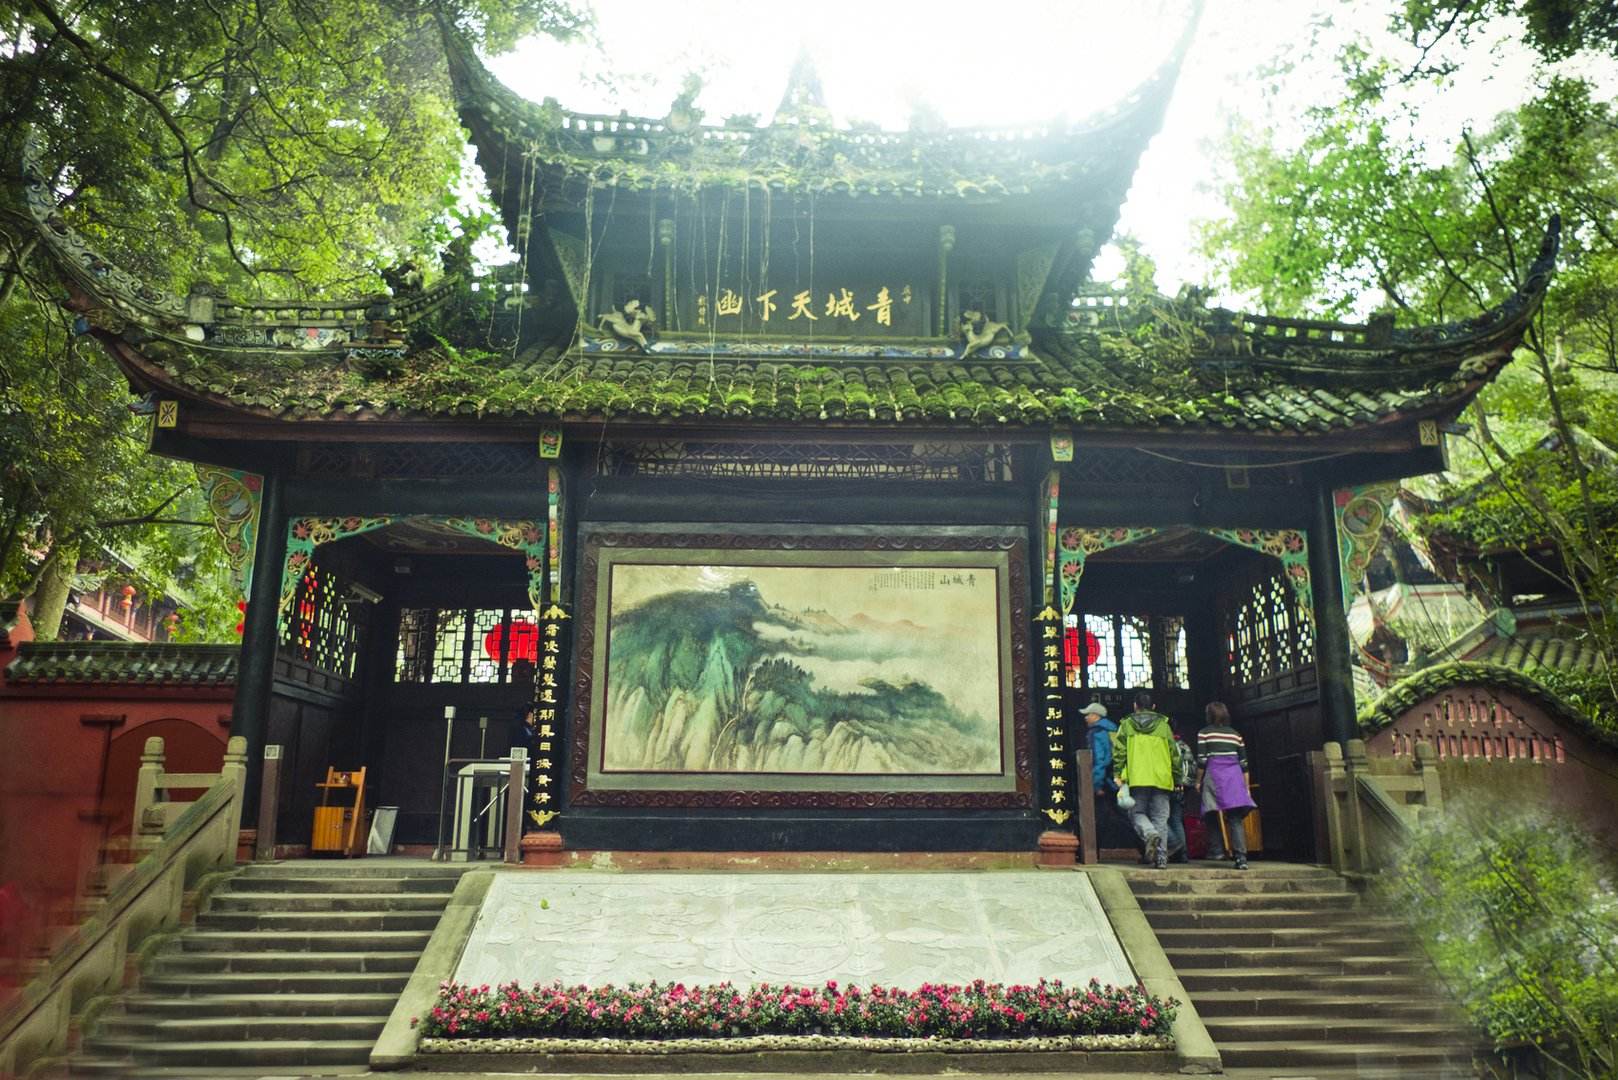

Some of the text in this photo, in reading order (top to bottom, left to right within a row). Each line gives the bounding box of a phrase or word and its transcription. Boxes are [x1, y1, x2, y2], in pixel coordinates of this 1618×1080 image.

[715, 286, 894, 327] 青城天下幽
[939, 573, 977, 588] 青城山
